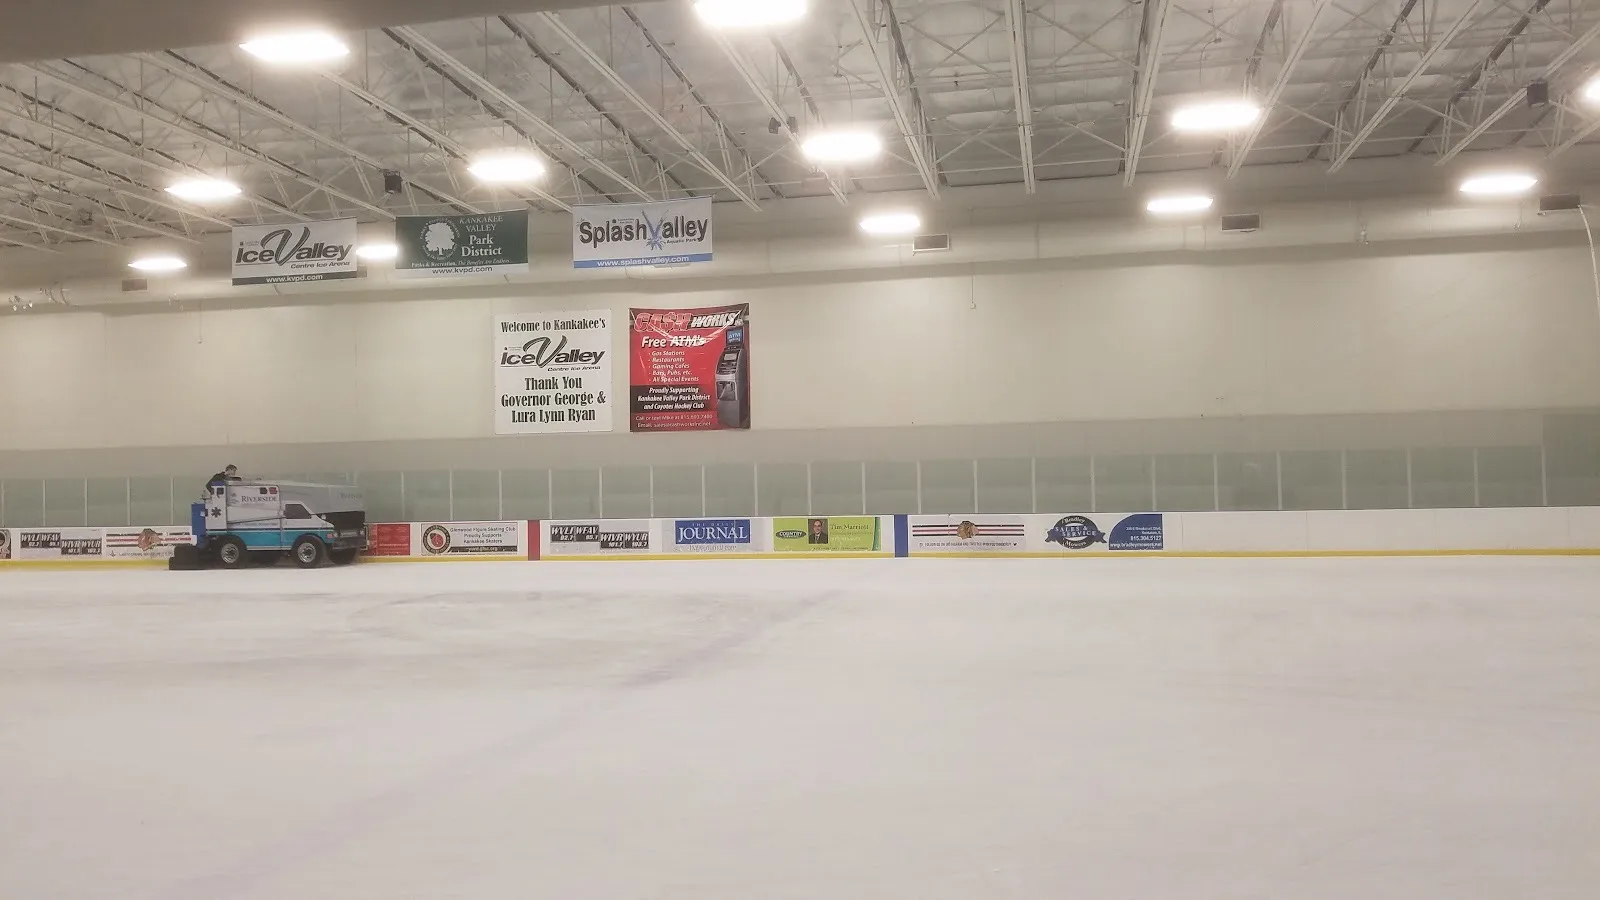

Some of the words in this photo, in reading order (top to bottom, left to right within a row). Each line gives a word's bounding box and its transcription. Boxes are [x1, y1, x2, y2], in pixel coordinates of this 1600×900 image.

[459, 215, 504, 224] KANKAKEE
[466, 224, 497, 232] VALLEY
[469, 234, 494, 245] Park
[461, 246, 502, 257] District
[597, 255, 690, 267] www.splashvalley.com
[432, 266, 493, 274] www.kvpd.com
[266, 274, 323, 283] www.kvpd.com
[501, 321, 540, 333] Welcome
[542, 319, 552, 331] to
[553, 317, 606, 331] Kankakee's
[641, 336, 666, 348] Free
[524, 376, 559, 391] Thank
[562, 376, 582, 389] You
[648, 387, 669, 395] Proudly
[669, 386, 699, 394] Supporting
[501, 394, 552, 407] Governor
[554, 391, 594, 406] George
[596, 390, 606, 404] &
[691, 393, 711, 401] District
[654, 403, 674, 411] Coyotes
[674, 402, 692, 410] Hockey
[511, 410, 536, 423] Lura
[539, 410, 565, 424] Lynn
[568, 408, 596, 422] Ryan
[576, 526, 599, 534] WFAV
[678, 526, 749, 543] JOURNAL
[600, 533, 624, 542] WIVR
[625, 533, 648, 541] WYUR
